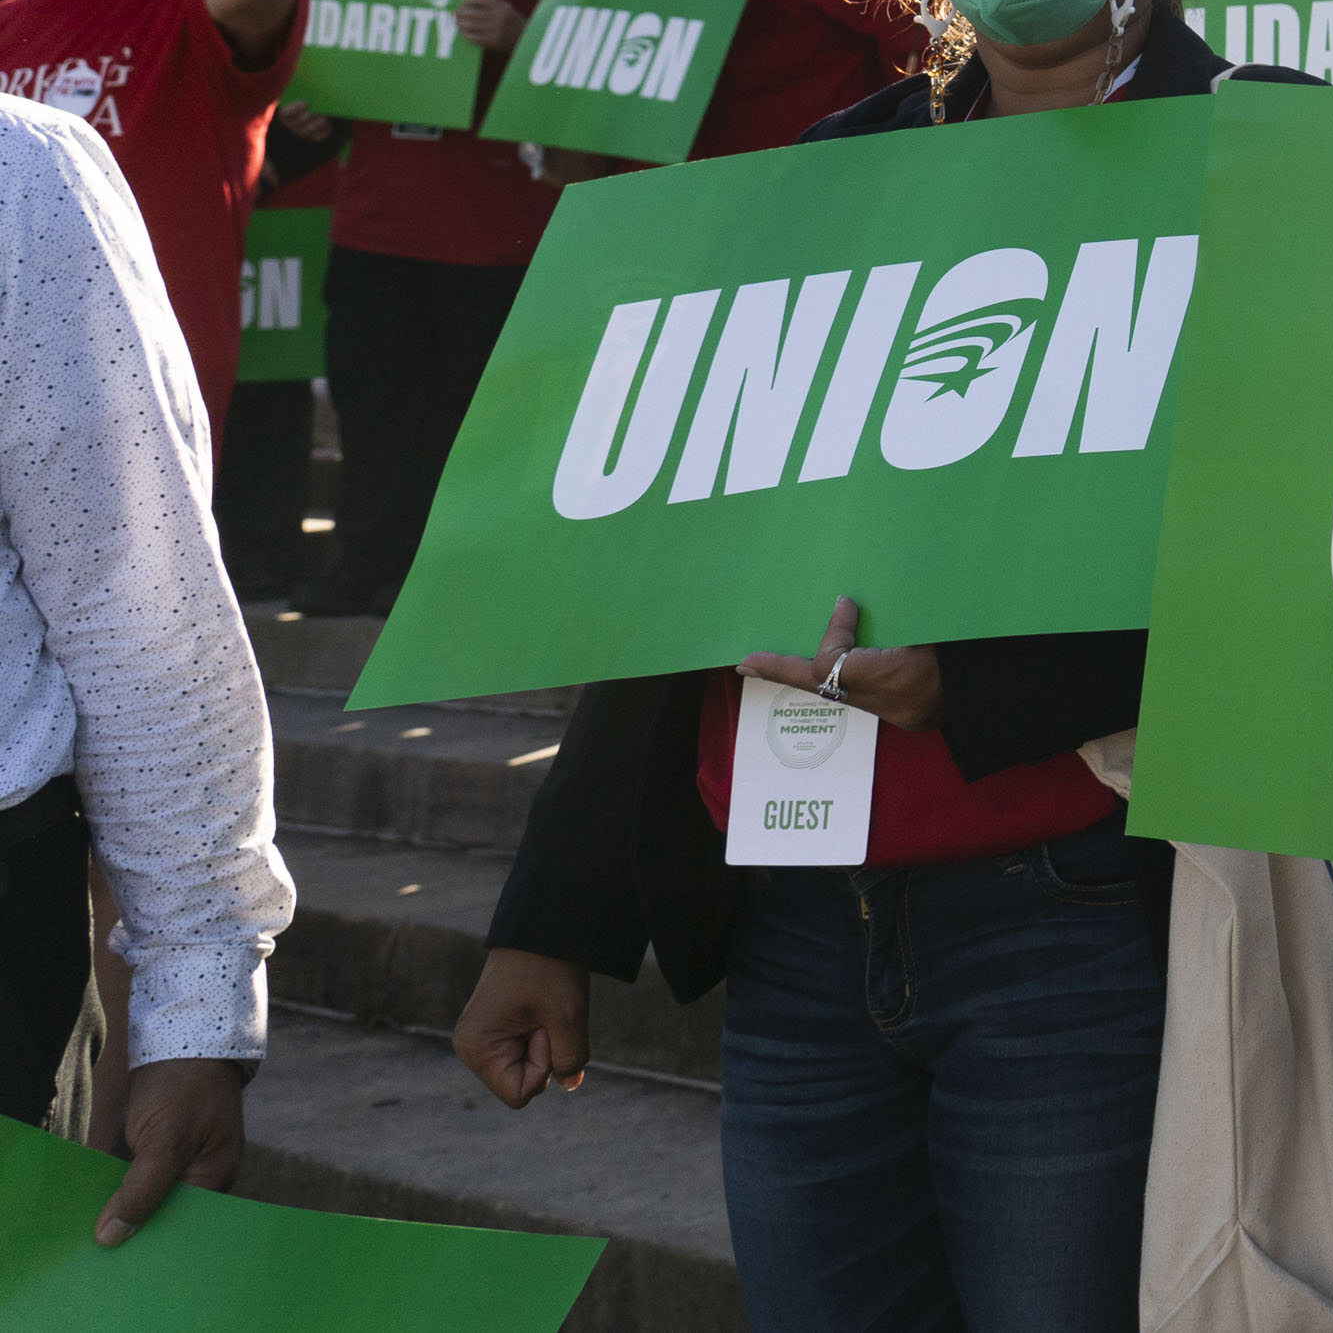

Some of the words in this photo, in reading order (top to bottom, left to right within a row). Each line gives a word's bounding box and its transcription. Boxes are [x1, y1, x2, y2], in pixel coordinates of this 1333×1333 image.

[528, 4, 705, 102] UNION
[552, 234, 1200, 521] UNION
[773, 707, 845, 717] MOVEMENT
[780, 725, 836, 734] MOMENT
[764, 799, 834, 831] GUEST
